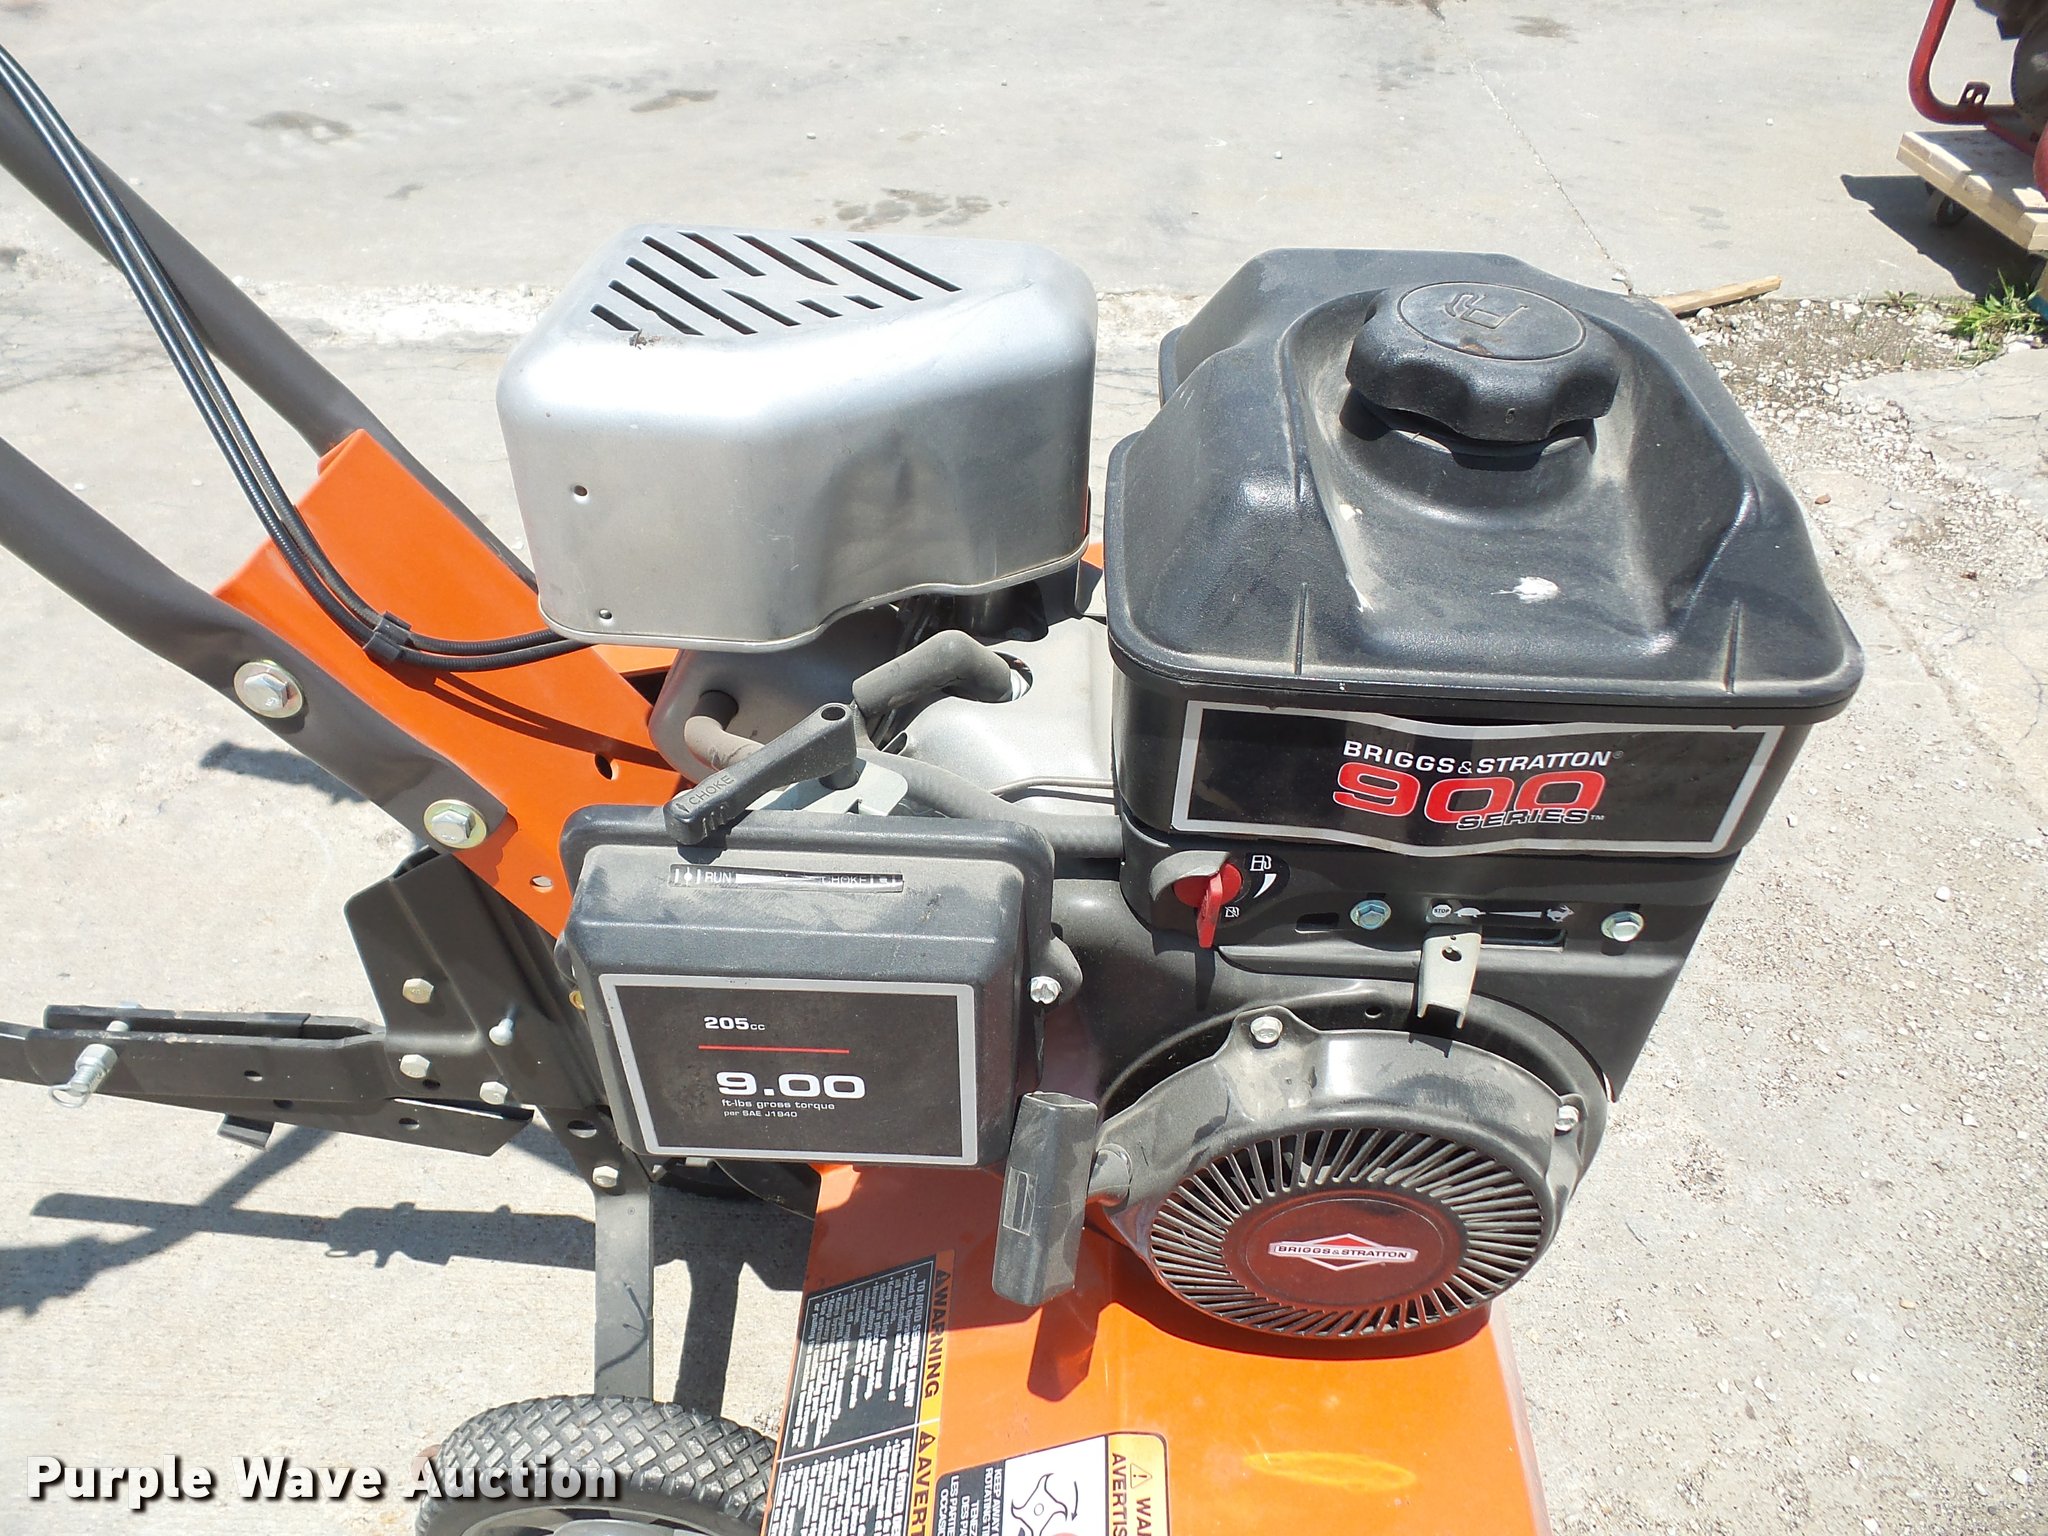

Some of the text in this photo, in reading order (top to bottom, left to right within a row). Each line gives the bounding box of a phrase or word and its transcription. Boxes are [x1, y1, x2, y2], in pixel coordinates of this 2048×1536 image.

[689, 775, 734, 804] CHOKE
[1333, 761, 1606, 823] 900
[705, 871, 731, 883] RUN
[716, 1071, 866, 1099] 9.00
[722, 1099, 835, 1110] ft-lbs gross torque
[912, 1292, 924, 1322] AVOID
[925, 1283, 948, 1398] WARNING
[950, 1475, 959, 1497] LES
[983, 1467, 993, 1523] ROTATING
[992, 1468, 1003, 1530] KEEP AWAY
[961, 1496, 970, 1520] DES
